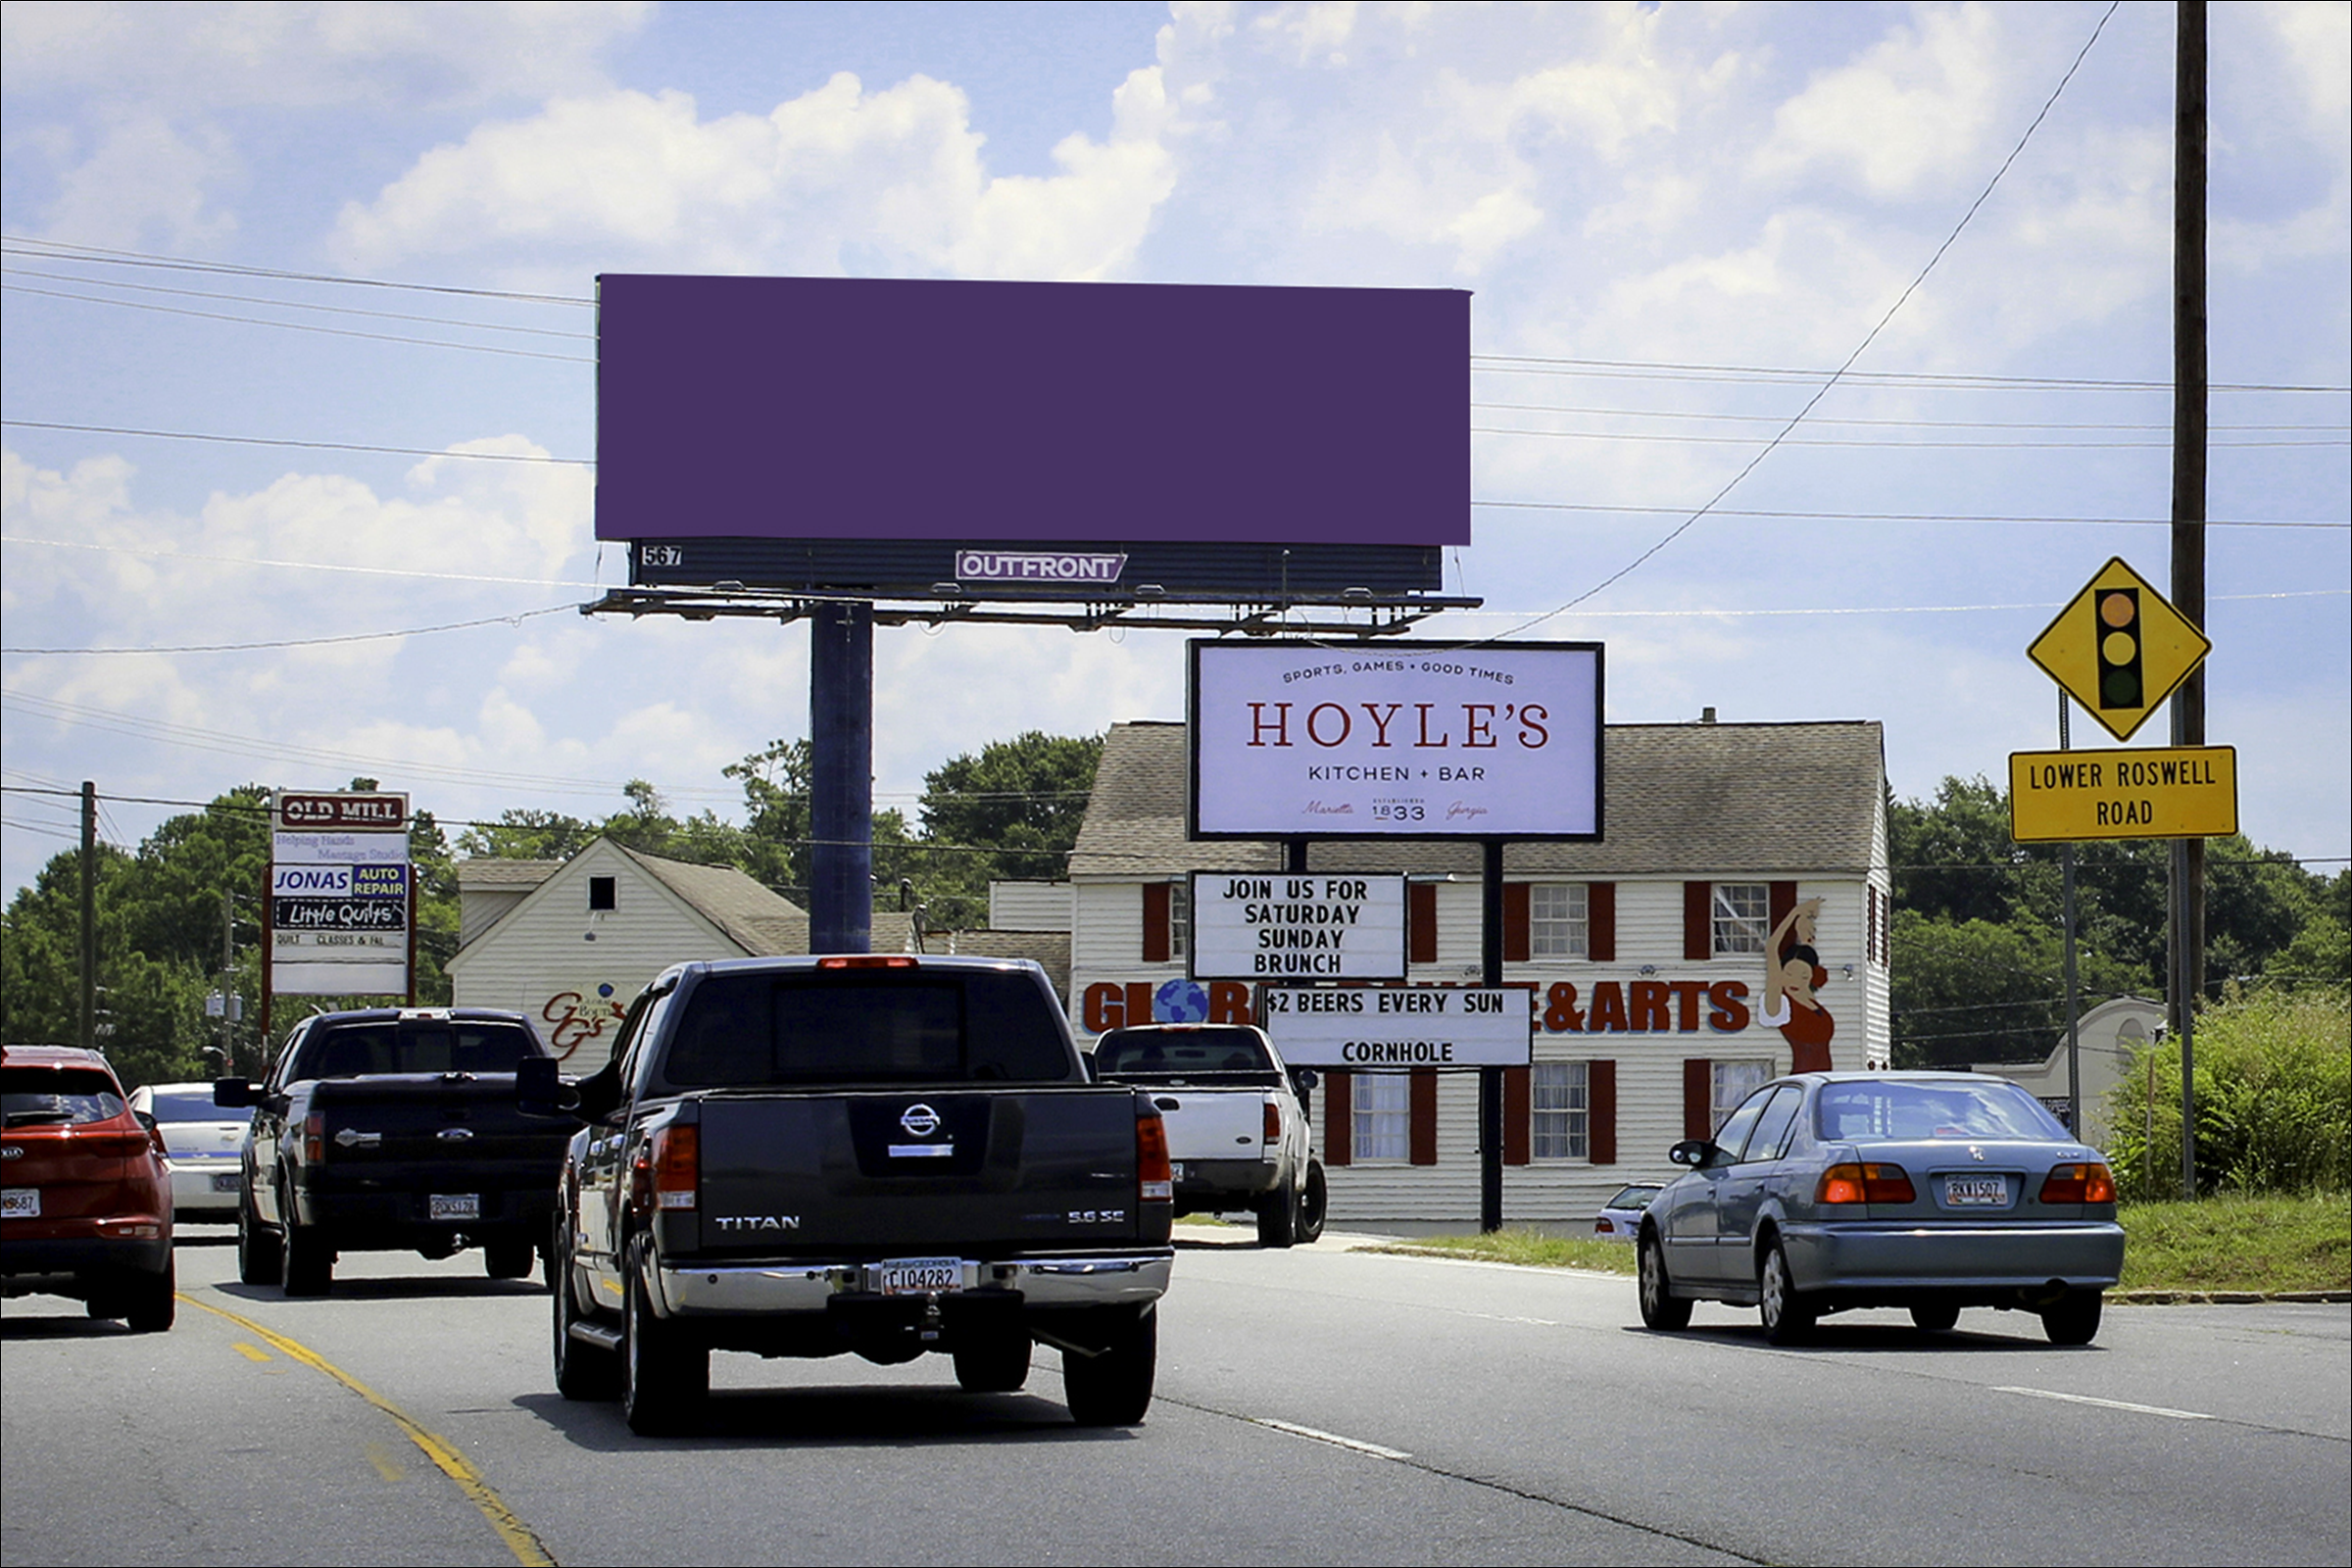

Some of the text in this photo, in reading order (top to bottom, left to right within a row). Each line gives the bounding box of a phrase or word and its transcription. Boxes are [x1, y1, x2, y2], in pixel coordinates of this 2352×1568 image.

[644, 546, 682, 565] 567
[962, 555, 1116, 579] OUTFRONT
[1283, 661, 1514, 685] SPORTS, GAMES GOOD TIMES
[1247, 702, 1549, 749] HOYLE'S
[1308, 765, 1486, 782] KITCHEN + BAR
[2031, 760, 2217, 790] LOWER ROSWELL
[286, 801, 397, 821] OLD MILL
[1373, 806, 1425, 820] 1833
[2097, 800, 2153, 825] ROAD
[276, 835, 355, 848] Helping Hands
[369, 849, 406, 859] Studio
[274, 871, 349, 890] JONAS
[359, 868, 399, 880] AUTO
[354, 883, 404, 895] REPAIR
[1224, 880, 1368, 900] JOIN US FOR
[289, 903, 392, 925] Little Quilts
[1245, 905, 1360, 924] SATURDAY
[1258, 930, 1344, 949] SUNDAY
[1254, 955, 1342, 973] BRUNCH
[1268, 993, 1503, 1013] $2 BEERS EVERY SUN
[1342, 1042, 1453, 1062] CORNHOLE
[715, 1216, 800, 1230] TITAN
[1068, 1210, 1125, 1224] 5.6 SE
